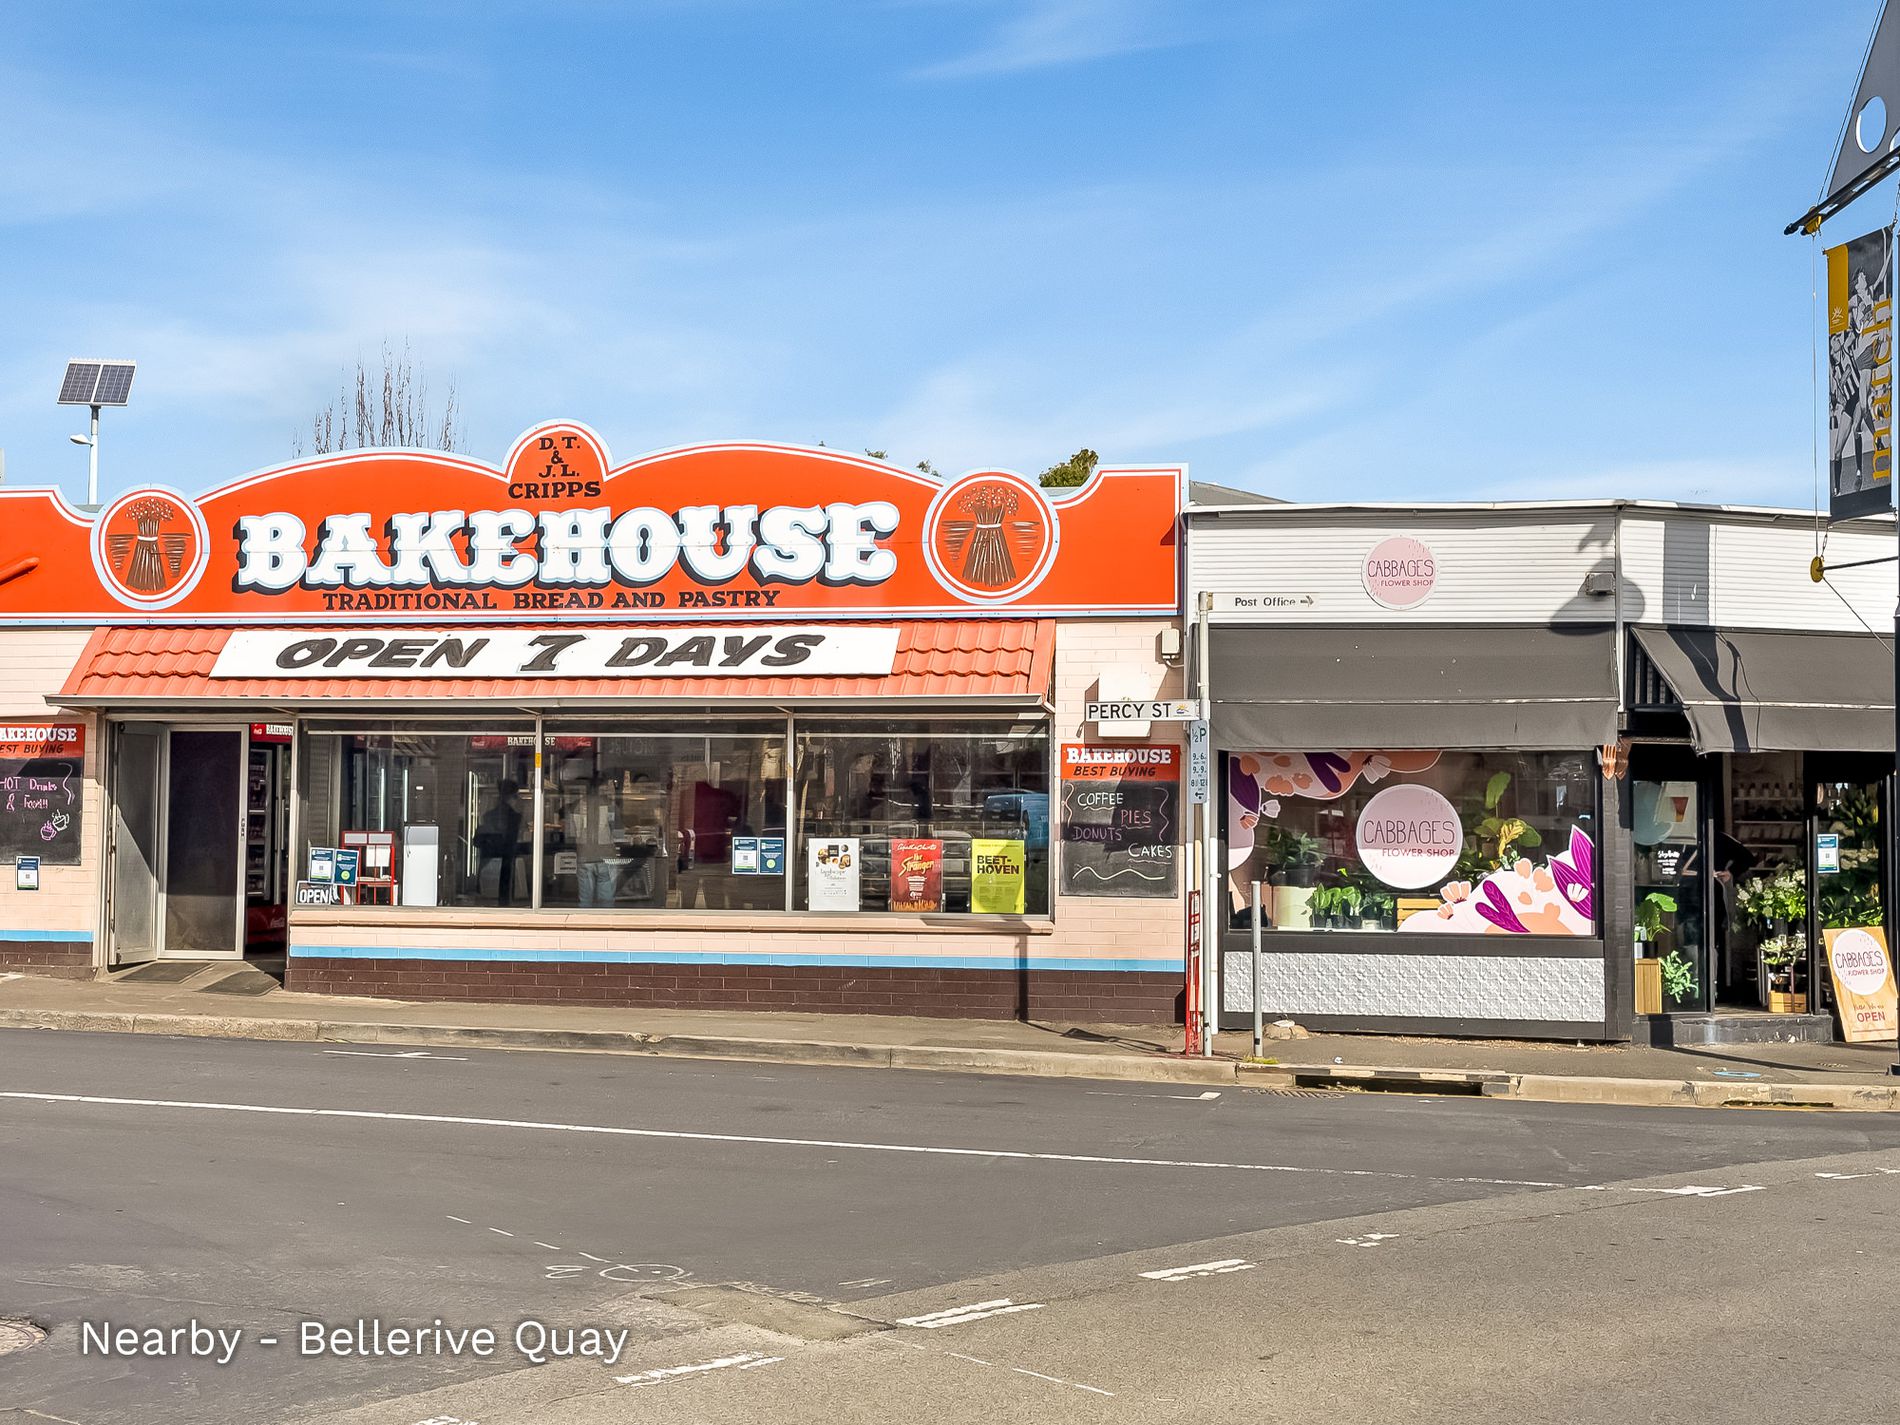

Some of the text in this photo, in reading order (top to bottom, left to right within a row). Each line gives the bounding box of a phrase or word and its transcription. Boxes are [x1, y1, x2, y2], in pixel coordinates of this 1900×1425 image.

[550, 451, 564, 465] &
[508, 481, 601, 499] CRIPPS
[232, 502, 900, 596] BAKEHOUSE
[1367, 559, 1434, 578] CABBAGES
[1380, 579, 1434, 587] FLOWER SHOP
[323, 589, 781, 611] TRADITIONAL BREAD AND PASTRY
[1234, 596, 1296, 607] Post Office
[276, 634, 826, 672] OPEN 7 DAYS
[1088, 702, 1172, 719] PERCY ST
[0, 727, 77, 742] AKEHOUSE
[507, 736, 555, 747] BAKEHSE
[0, 744, 65, 754] EST BUYING
[1066, 748, 1171, 764] BAKEHOUSE
[1073, 765, 1157, 777] BEST BUYING
[6, 792, 15, 812] &
[1077, 791, 1124, 807] COFFEE
[1121, 809, 1151, 825] PIES
[1072, 826, 1123, 841] DONUTS
[1363, 820, 1455, 845] CABBAGES
[1127, 842, 1173, 859] CAKES
[1382, 847, 1455, 858] FLOWER SHOP
[976, 855, 1012, 865] BEET-
[976, 864, 1020, 875] HOVEN
[299, 888, 329, 904] OPEN
[1834, 950, 1884, 969] CABBAGES
[1870, 967, 1885, 976] SHOP
[1856, 1010, 1886, 1023] OPEN
